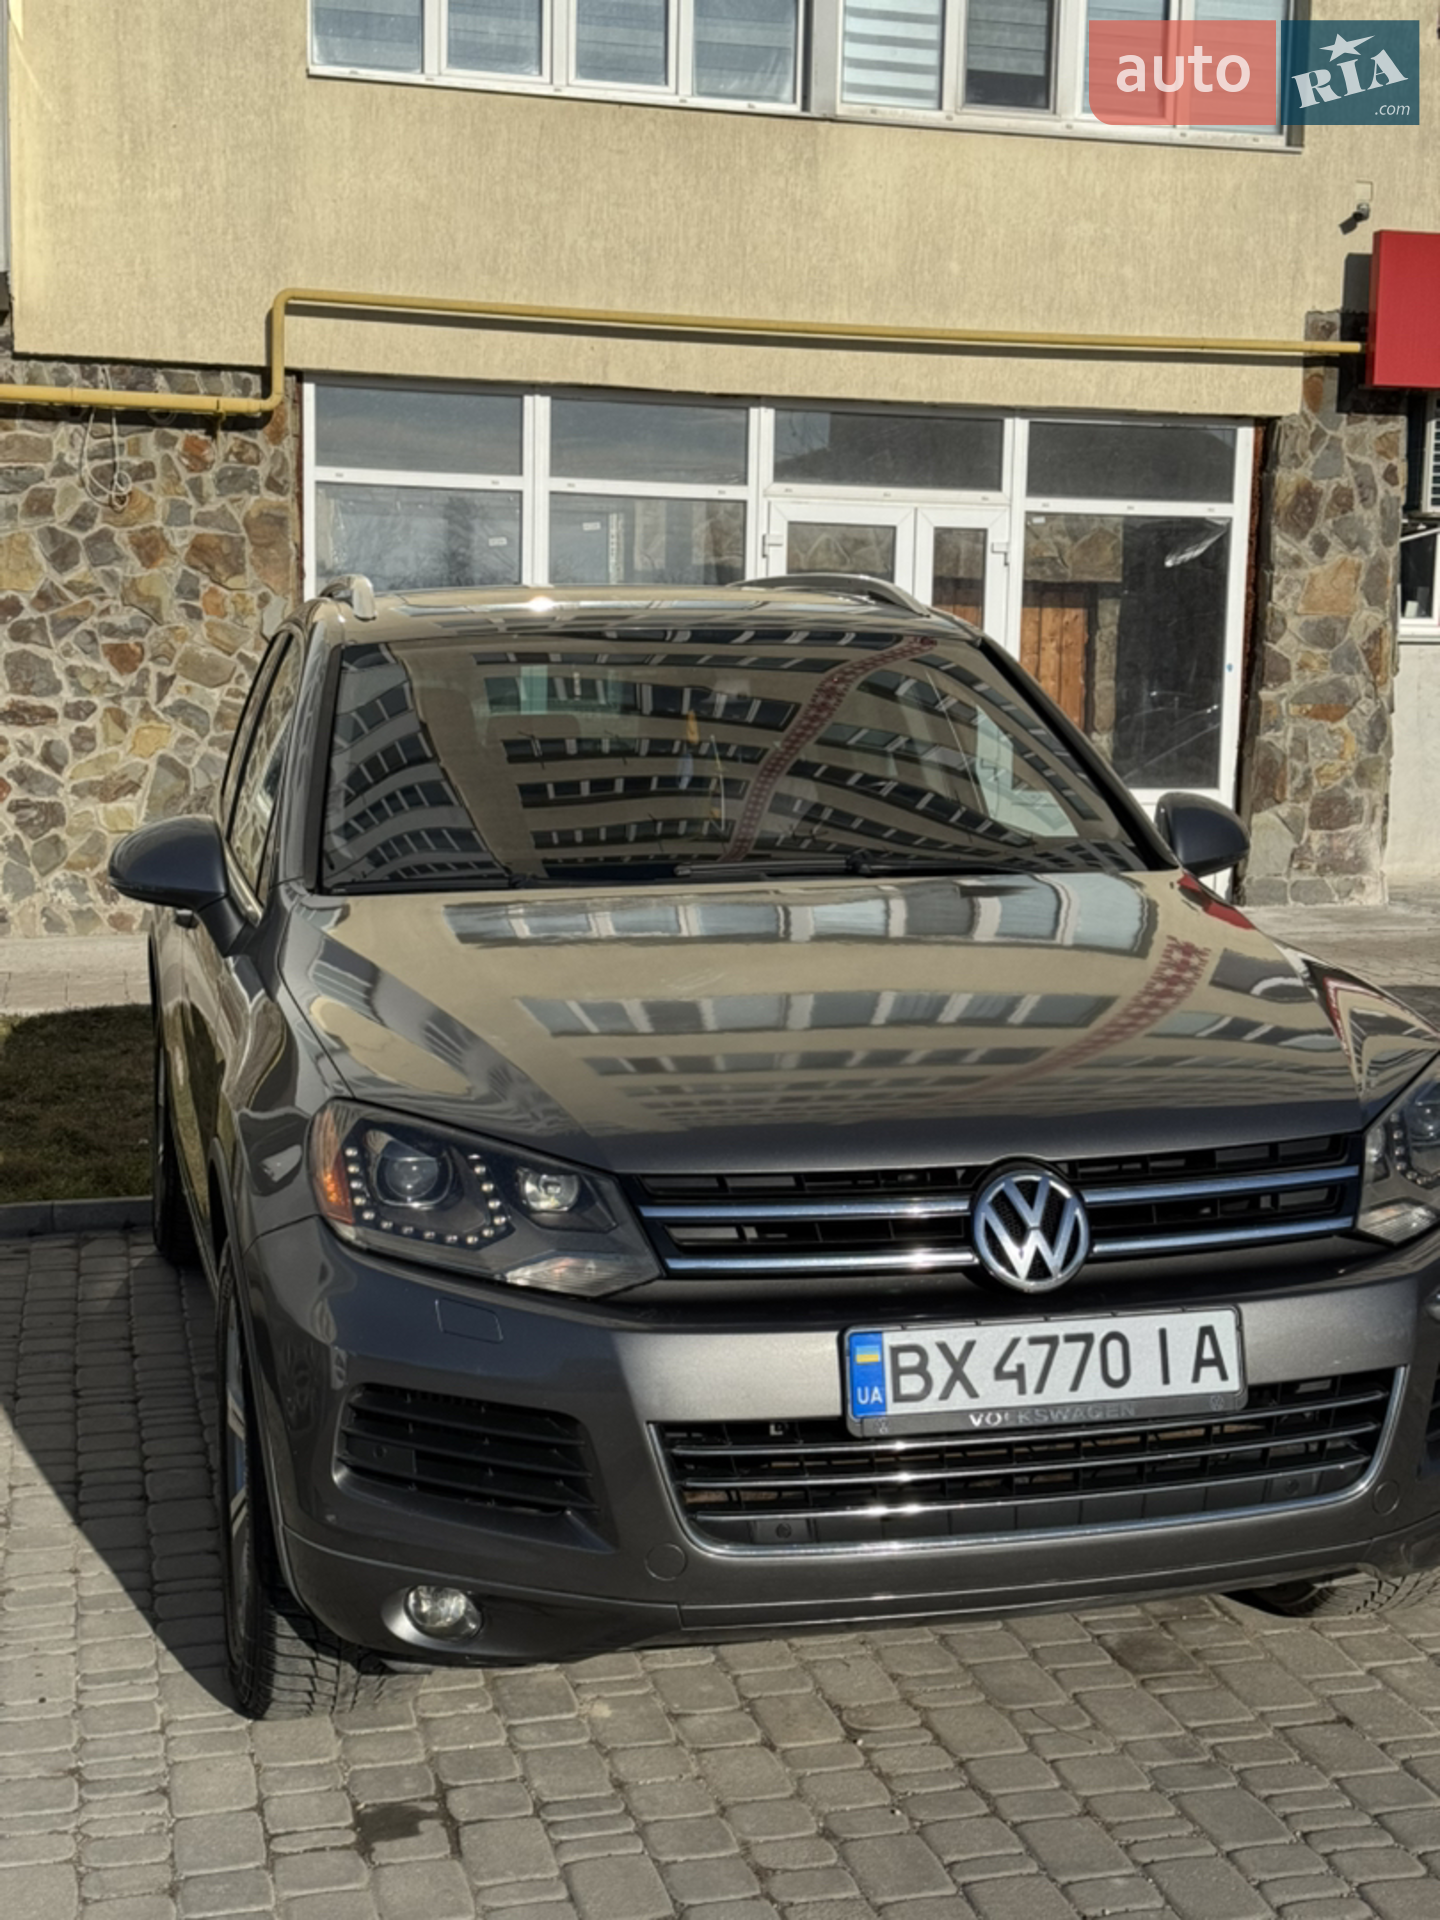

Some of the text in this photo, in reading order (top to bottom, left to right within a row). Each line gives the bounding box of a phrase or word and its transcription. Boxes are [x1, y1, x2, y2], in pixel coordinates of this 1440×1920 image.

[889, 1340, 980, 1404] BX
[993, 1331, 1131, 1396] 4770
[857, 1386, 883, 1405] UA
